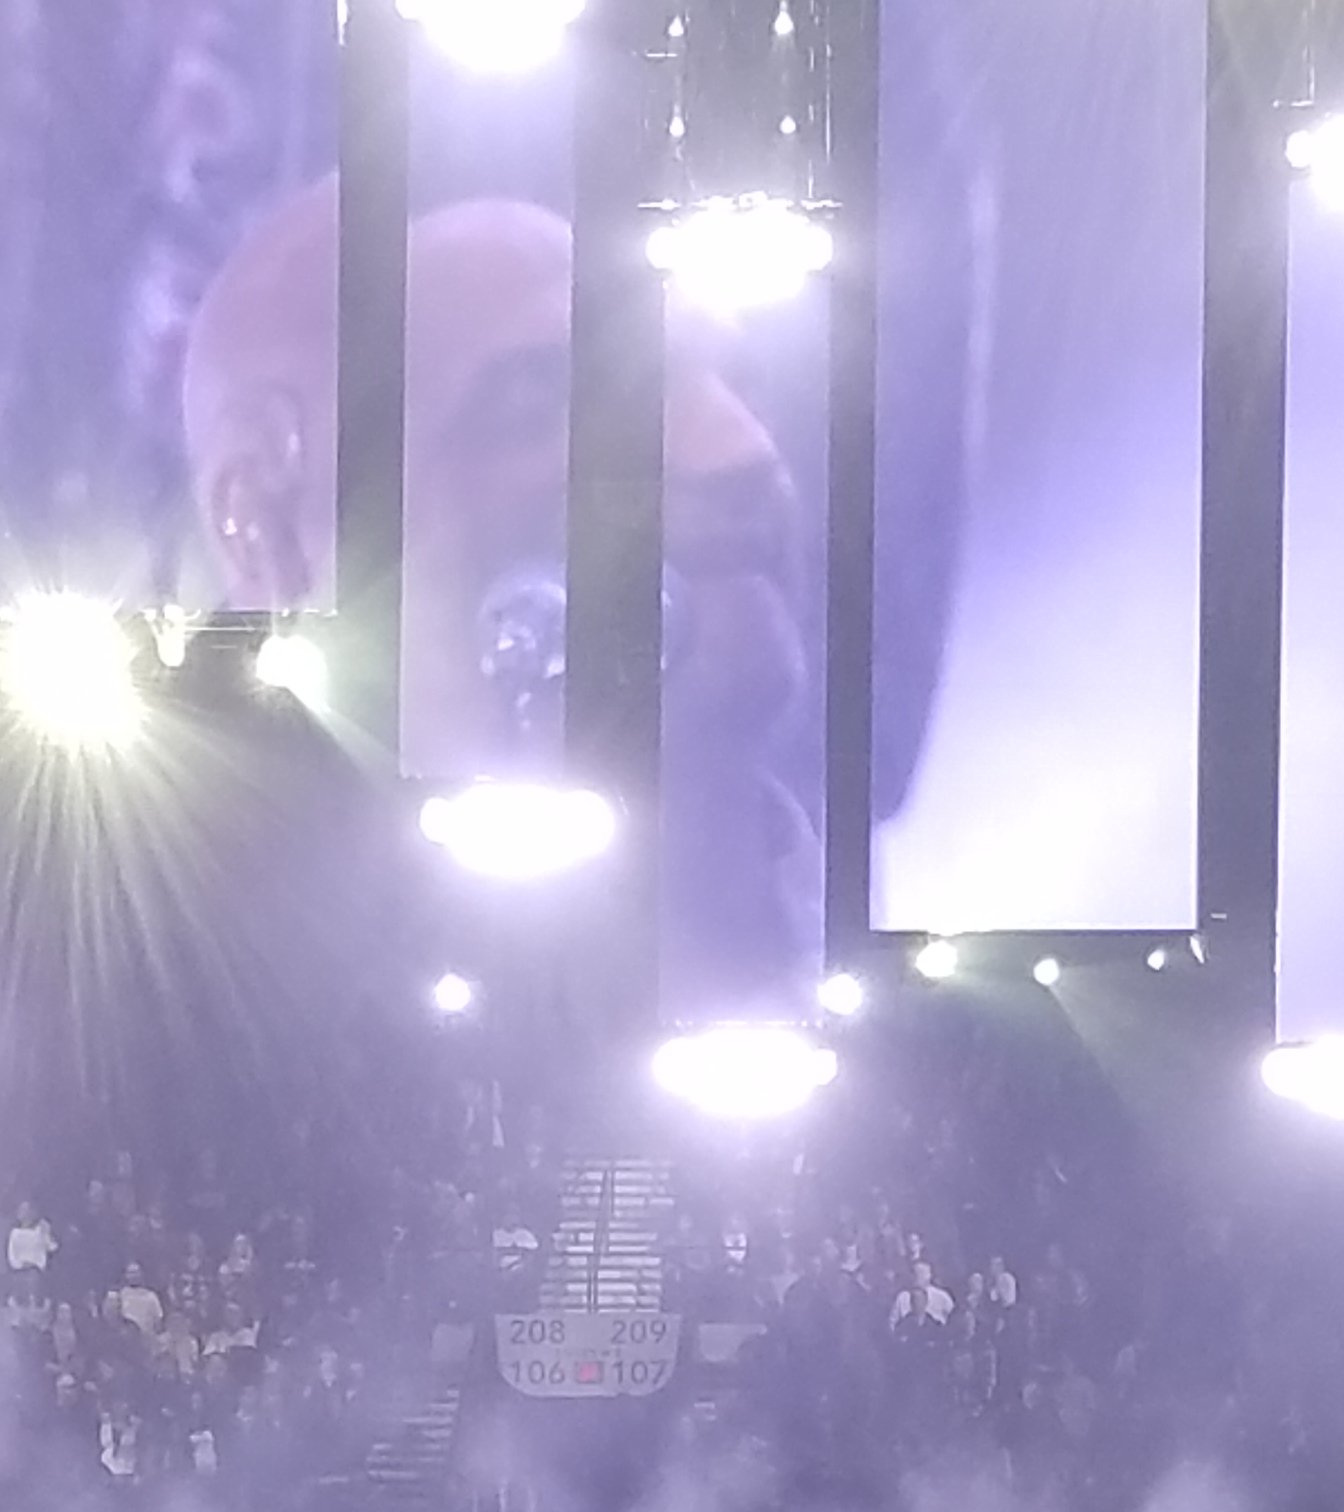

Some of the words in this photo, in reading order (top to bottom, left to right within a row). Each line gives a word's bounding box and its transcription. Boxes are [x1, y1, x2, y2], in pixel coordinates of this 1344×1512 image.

[510, 1319, 566, 1344] 208
[610, 1319, 667, 1344] 209
[510, 1360, 566, 1385] 106
[611, 1360, 668, 1385] 107
